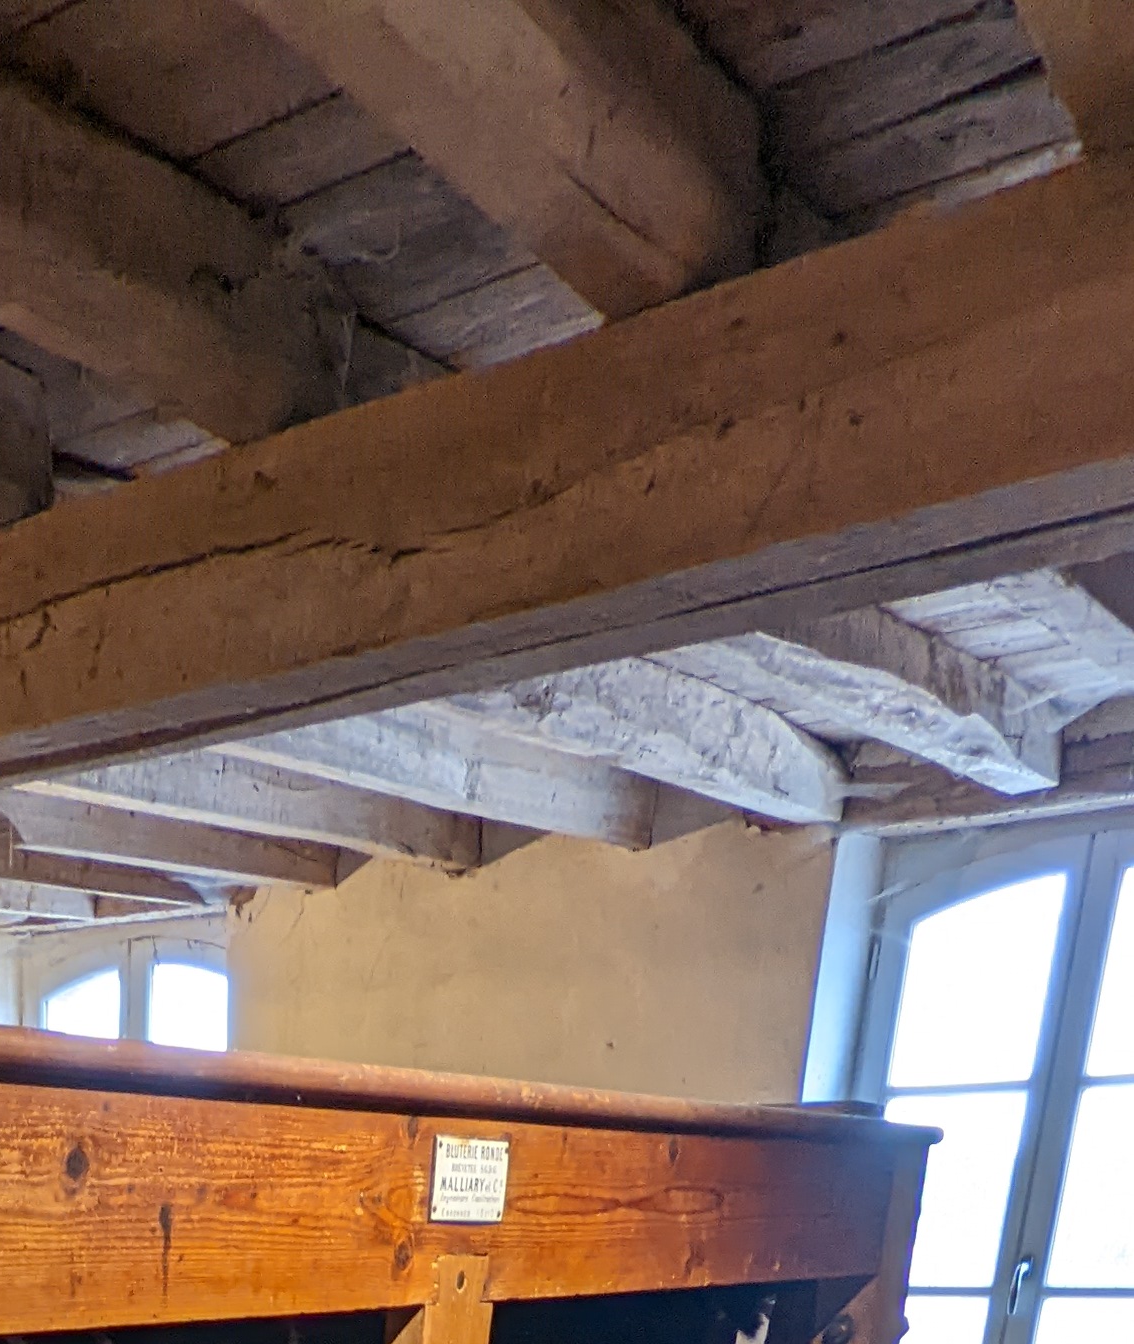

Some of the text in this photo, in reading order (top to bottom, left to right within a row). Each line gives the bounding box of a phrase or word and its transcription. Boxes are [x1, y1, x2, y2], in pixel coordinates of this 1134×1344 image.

[446, 1143, 503, 1161] BLUTERIE RONDE
[440, 1177, 485, 1192] MALLIARY
